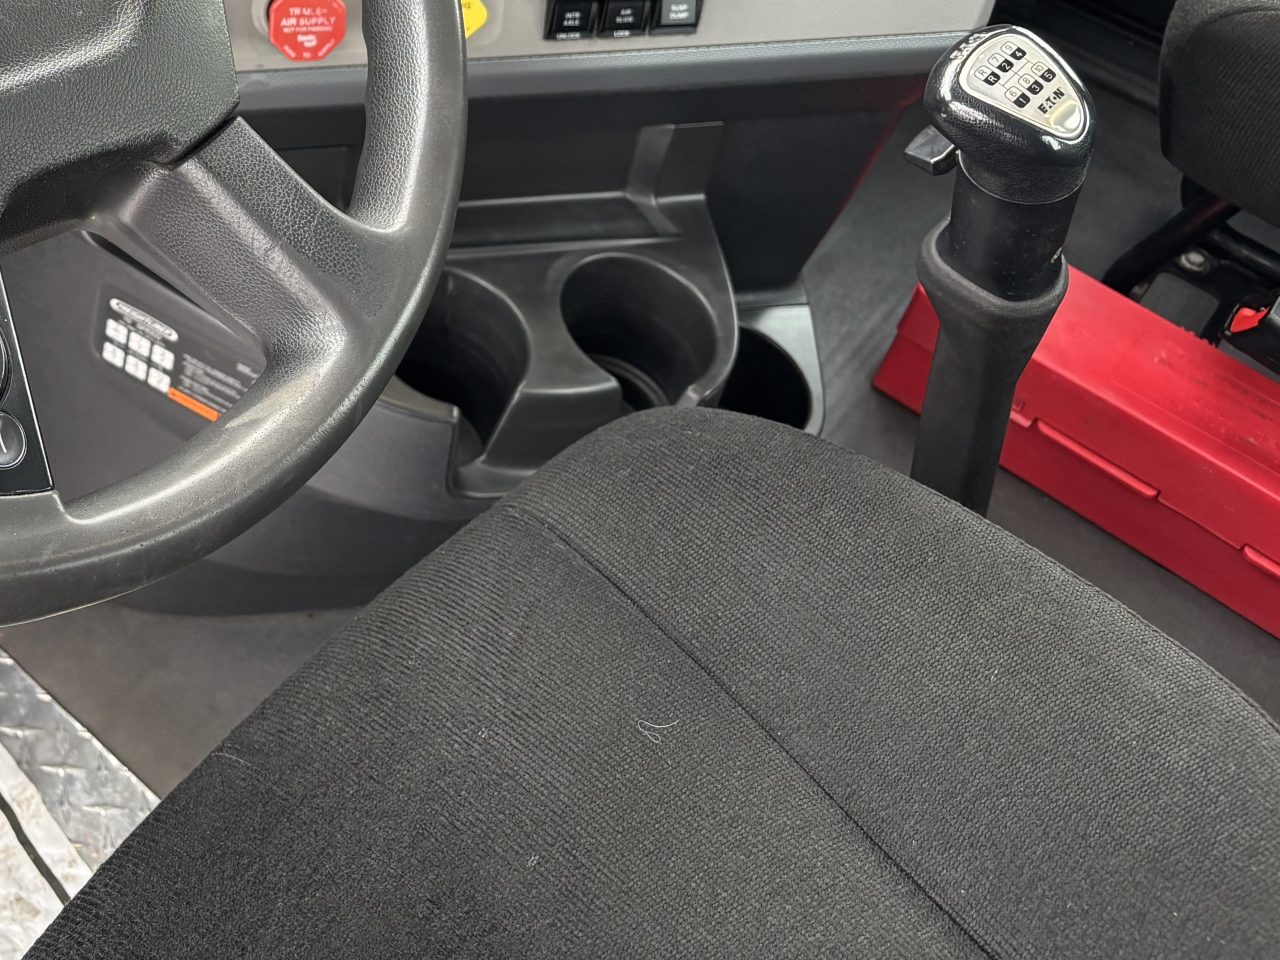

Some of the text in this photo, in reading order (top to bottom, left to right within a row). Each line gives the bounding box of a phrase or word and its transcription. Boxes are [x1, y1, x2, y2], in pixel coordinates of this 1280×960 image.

[280, 16, 336, 26] AIR SUPPLY
[1004, 43, 1013, 52] 9
[1014, 49, 1024, 59] 4
[991, 56, 1001, 64] 7
[1001, 62, 1011, 71] 2
[1034, 63, 1045, 73] 10
[979, 68, 988, 77] R
[1043, 71, 1053, 80] 5
[988, 74, 998, 84] R
[1022, 77, 1031, 85] 8
[1009, 89, 1018, 98] 6
[1032, 85, 1041, 93] 3
[1018, 97, 1028, 105] 1
